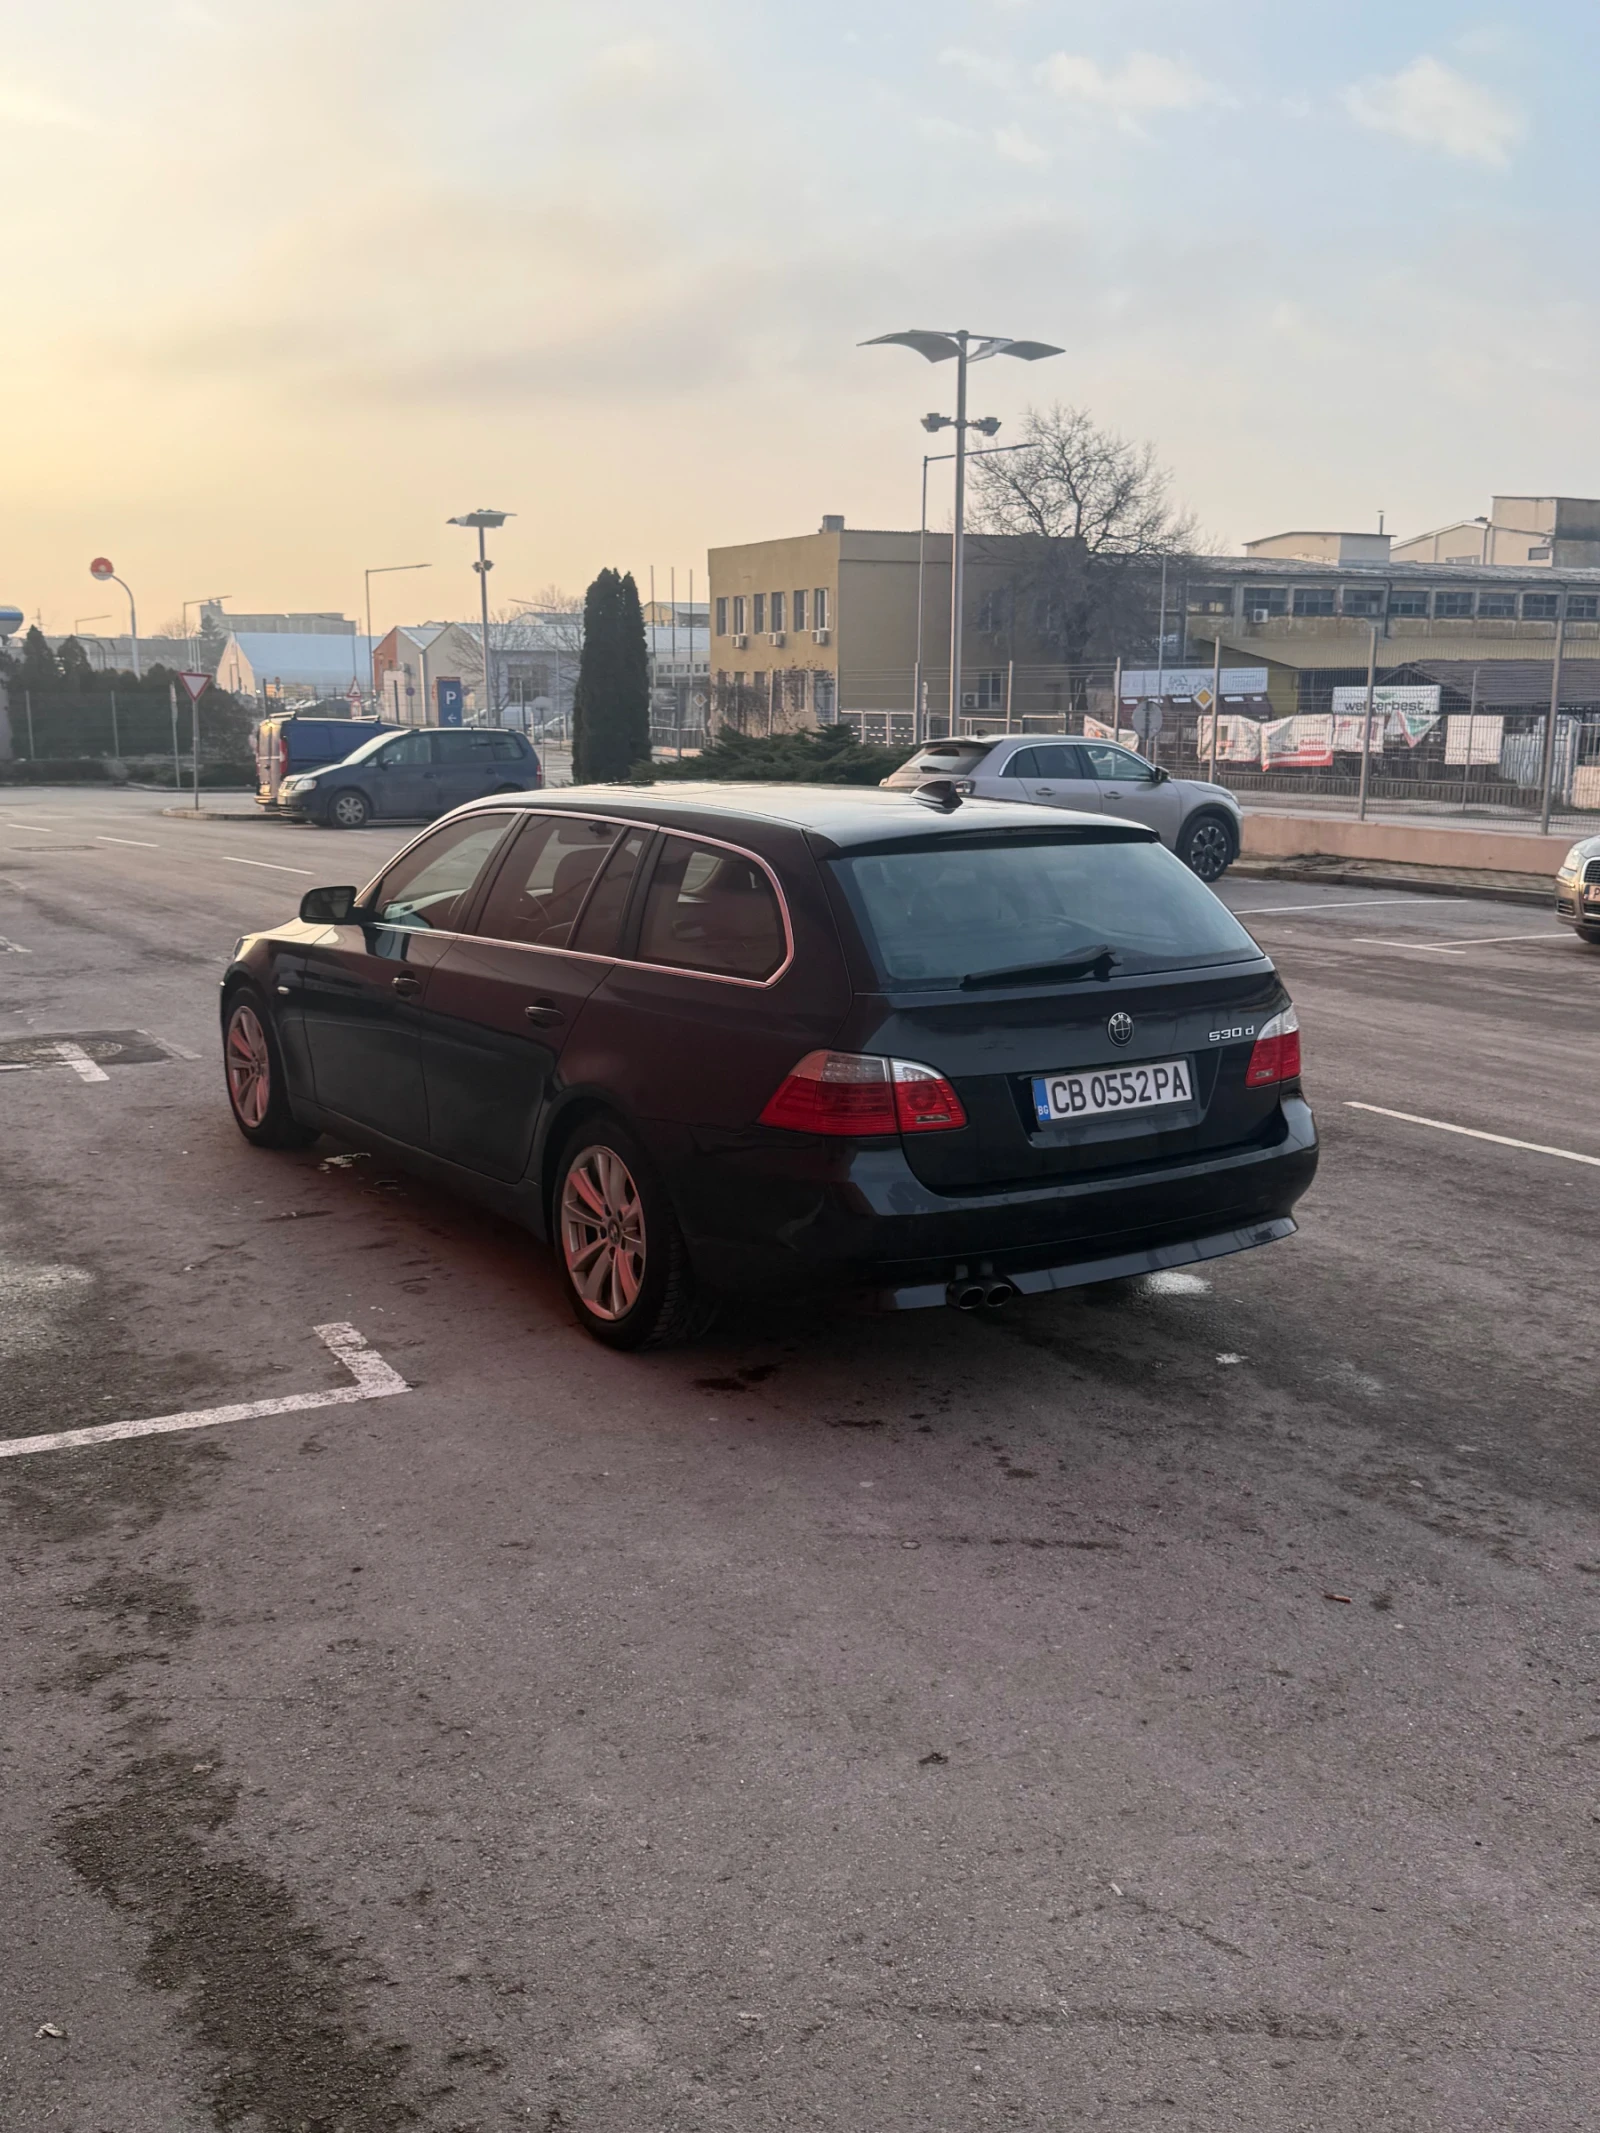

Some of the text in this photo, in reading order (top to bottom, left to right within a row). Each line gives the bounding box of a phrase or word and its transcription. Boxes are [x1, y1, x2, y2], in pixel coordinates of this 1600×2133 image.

[446, 691, 457, 705] P
[1344, 700, 1424, 711] weerbest
[1037, 1105, 1049, 1116] BG
